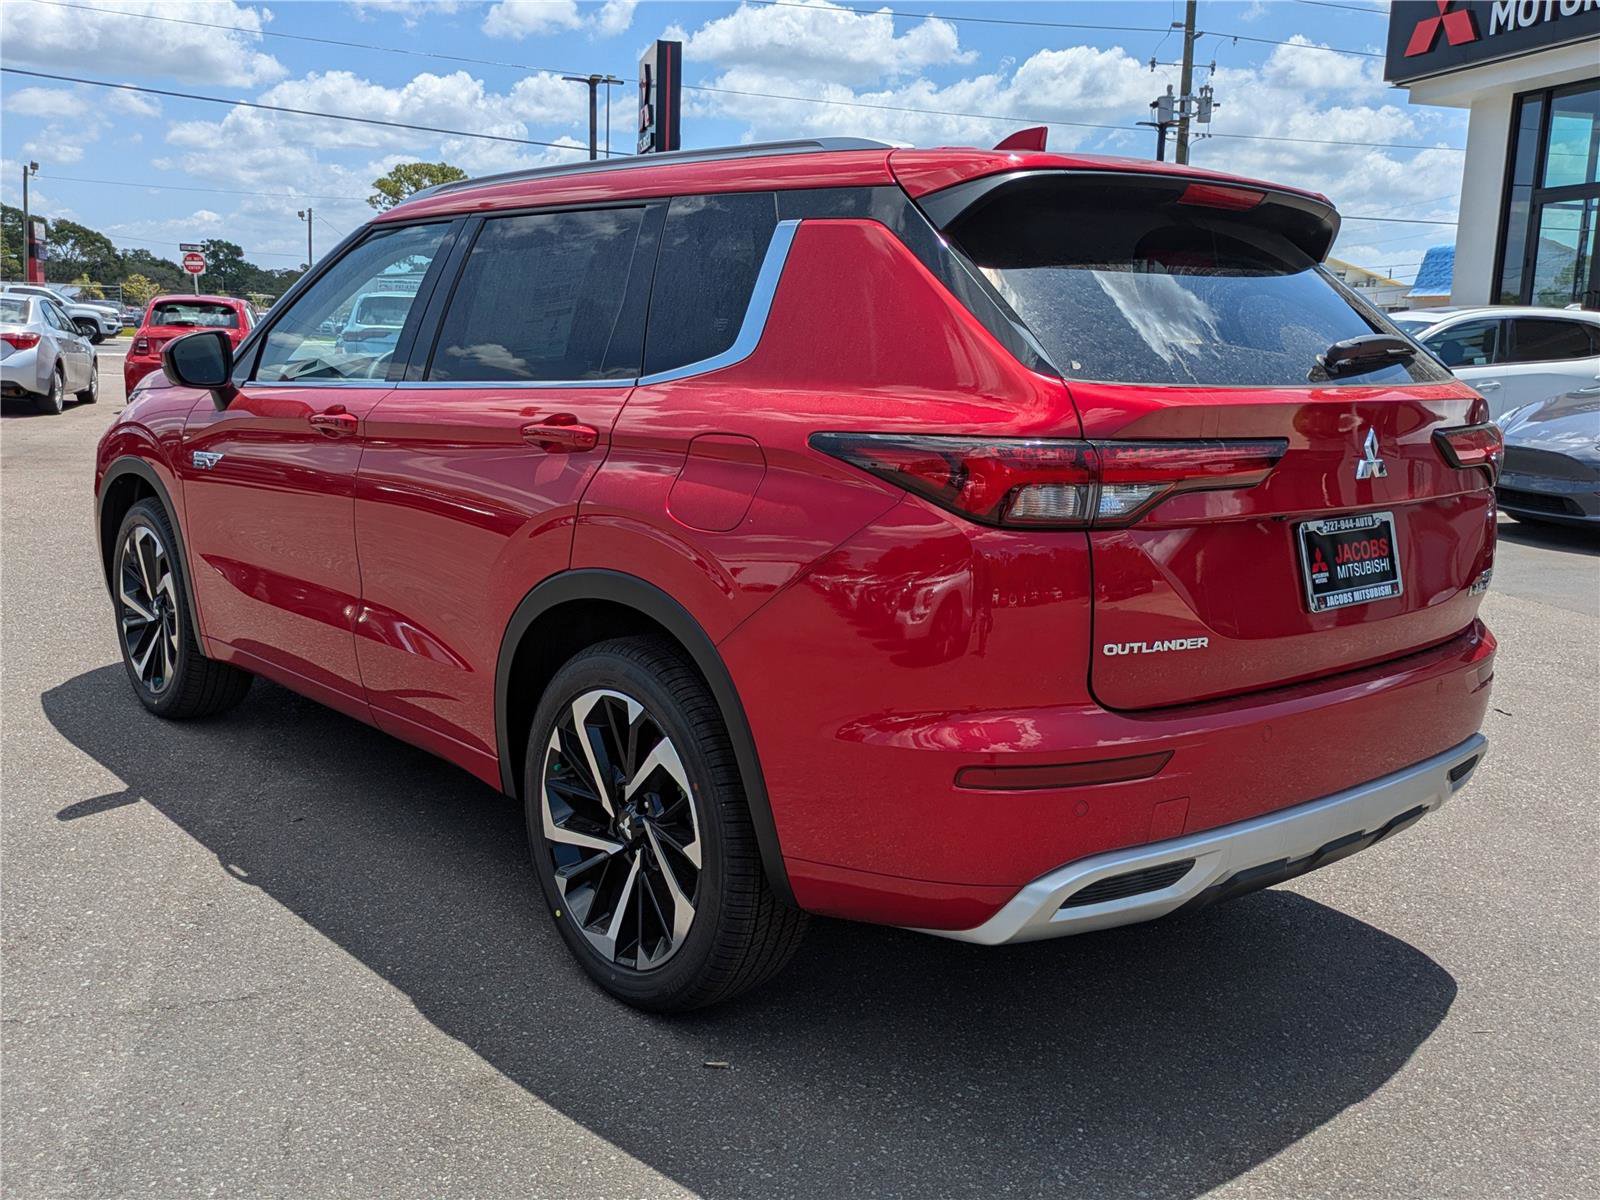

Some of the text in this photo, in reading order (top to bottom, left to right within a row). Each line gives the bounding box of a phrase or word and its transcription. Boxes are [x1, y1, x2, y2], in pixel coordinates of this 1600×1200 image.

[1325, 516, 1373, 532] 727-944-AUTO
[1335, 538, 1389, 564] JACOBS
[1337, 558, 1390, 579] MITSUBISHI
[1326, 585, 1392, 607] JACOBS MITSUBISHI
[1103, 637, 1209, 656] OUTLANDER
